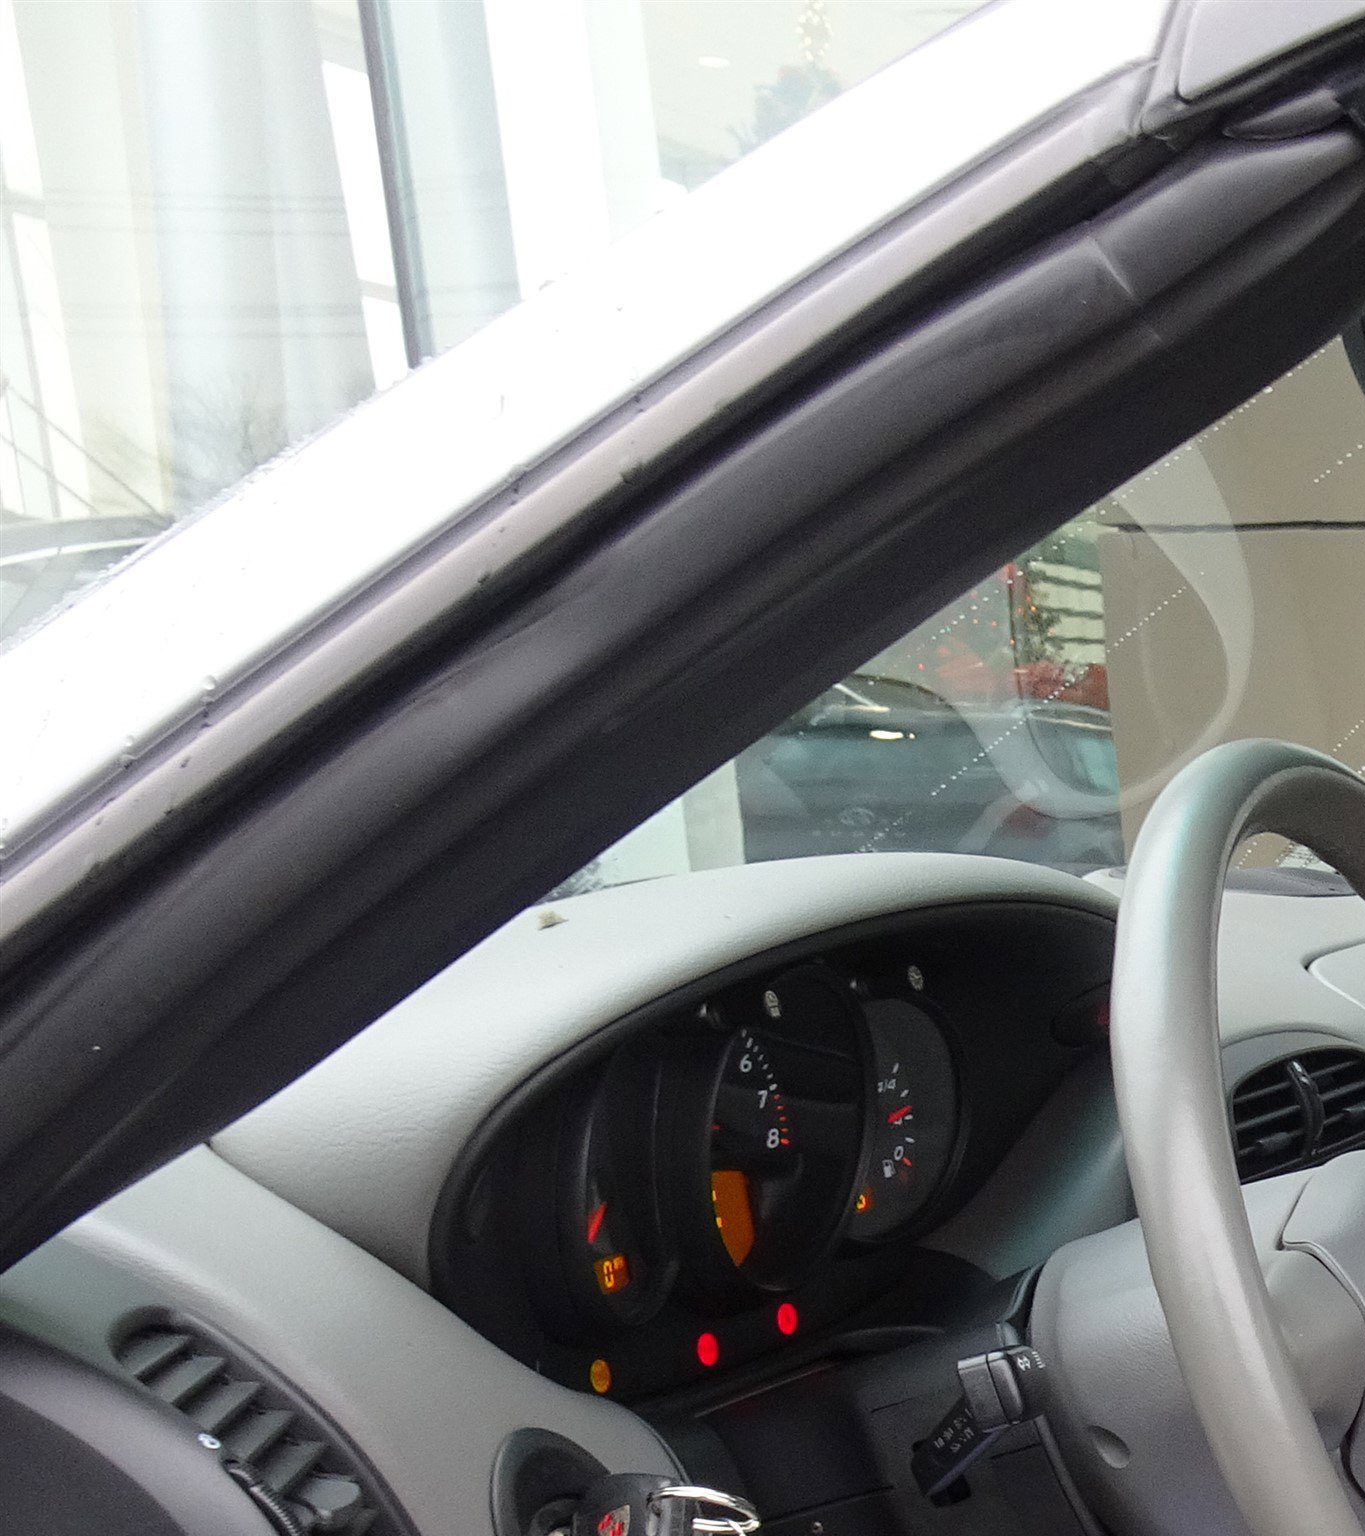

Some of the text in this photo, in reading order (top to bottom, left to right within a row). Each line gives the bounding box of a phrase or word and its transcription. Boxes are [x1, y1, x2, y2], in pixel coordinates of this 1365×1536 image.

[739, 1053, 752, 1073] 6
[757, 1089, 768, 1109] 7
[766, 1127, 779, 1149] 8
[893, 1145, 904, 1161] 0
